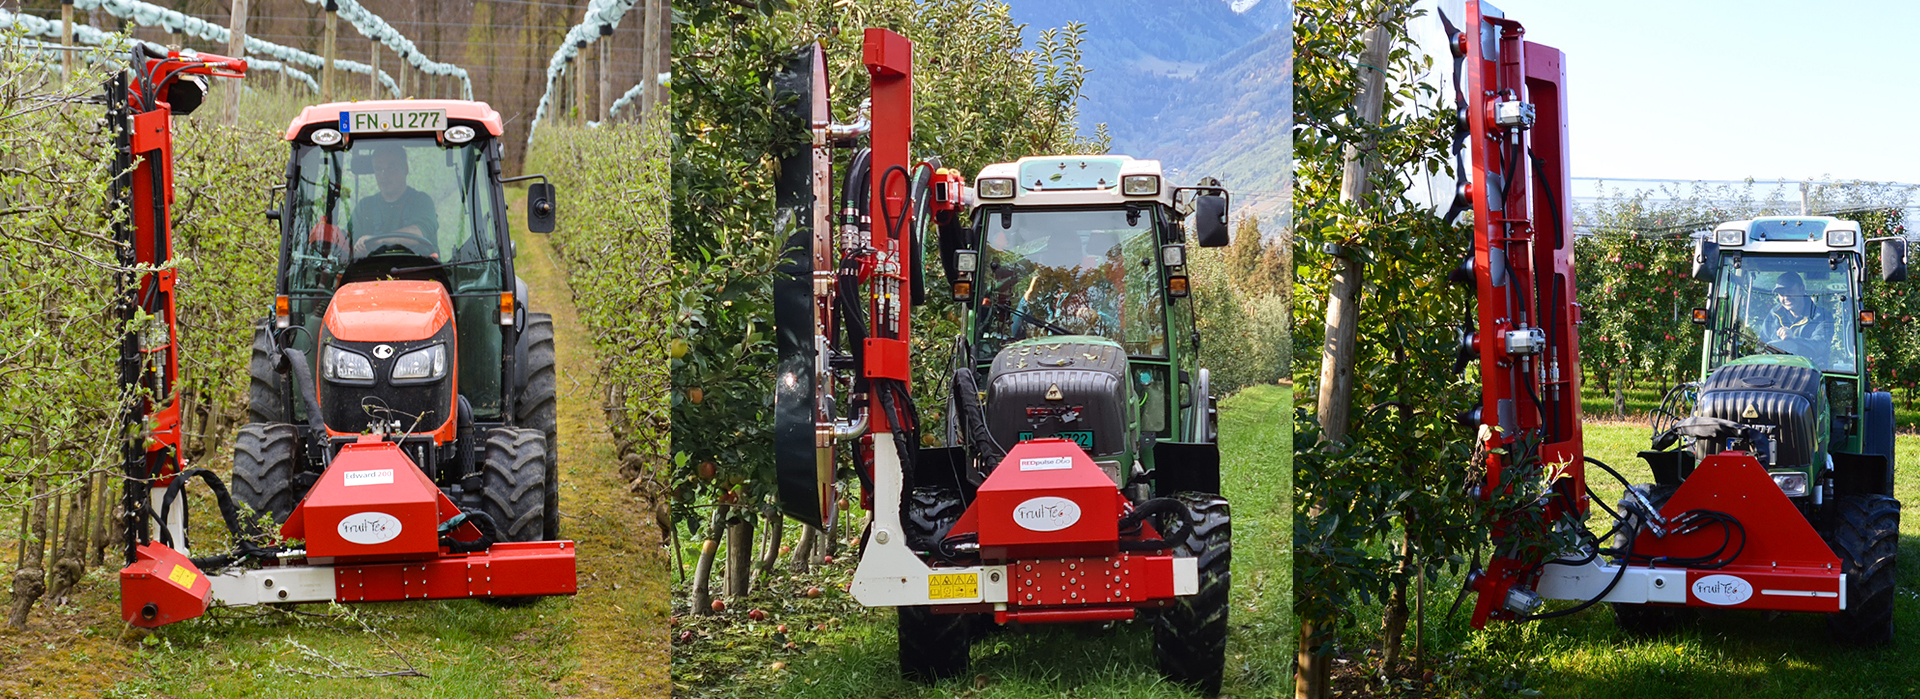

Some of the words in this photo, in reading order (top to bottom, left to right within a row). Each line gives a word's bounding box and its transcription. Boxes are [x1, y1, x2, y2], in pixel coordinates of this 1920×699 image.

[355, 113, 378, 129] FN
[392, 113, 403, 128] U
[408, 112, 440, 128] 277
[1048, 433, 1089, 446] 722
[345, 471, 377, 480] Edward
